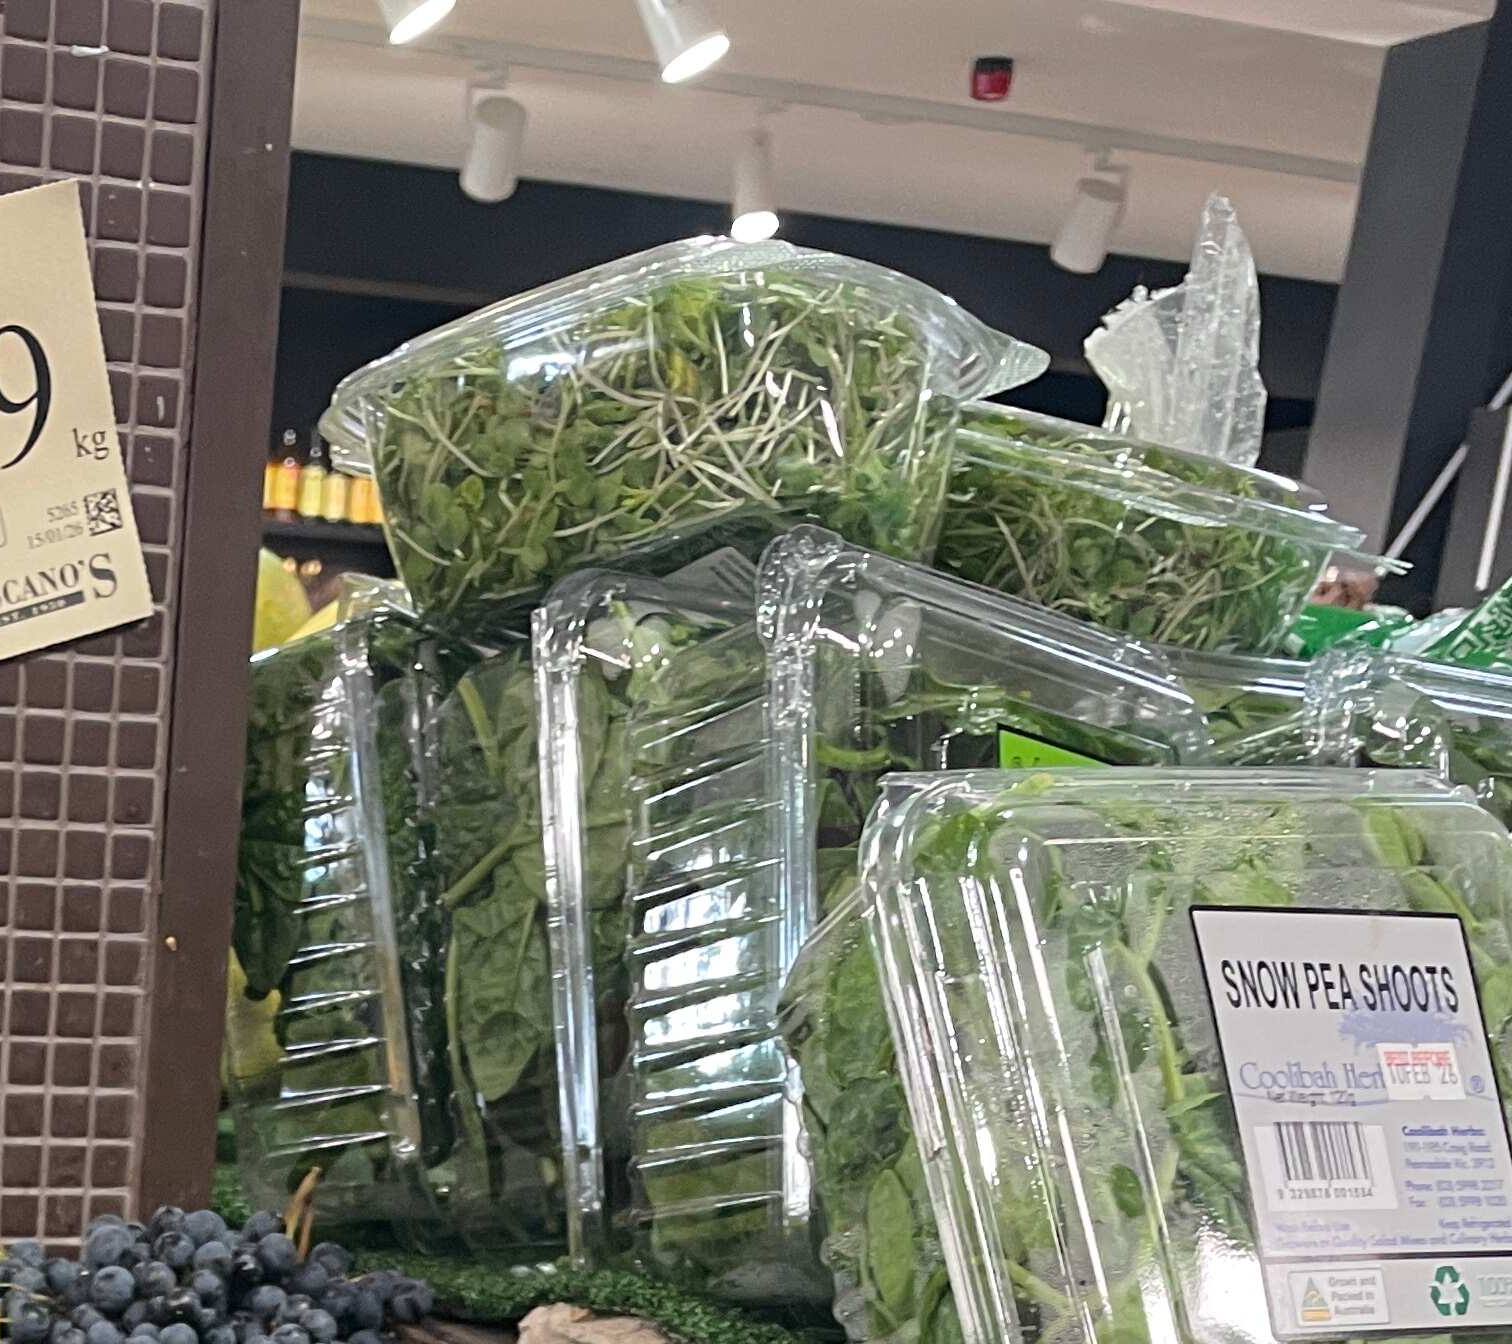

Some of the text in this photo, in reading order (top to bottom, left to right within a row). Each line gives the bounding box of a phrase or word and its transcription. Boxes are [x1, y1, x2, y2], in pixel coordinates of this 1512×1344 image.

[72, 427, 111, 461] kg
[1221, 959, 1460, 1014] SNOW PEA SHOOTS
[1239, 1062, 1338, 1090] Coolibah
